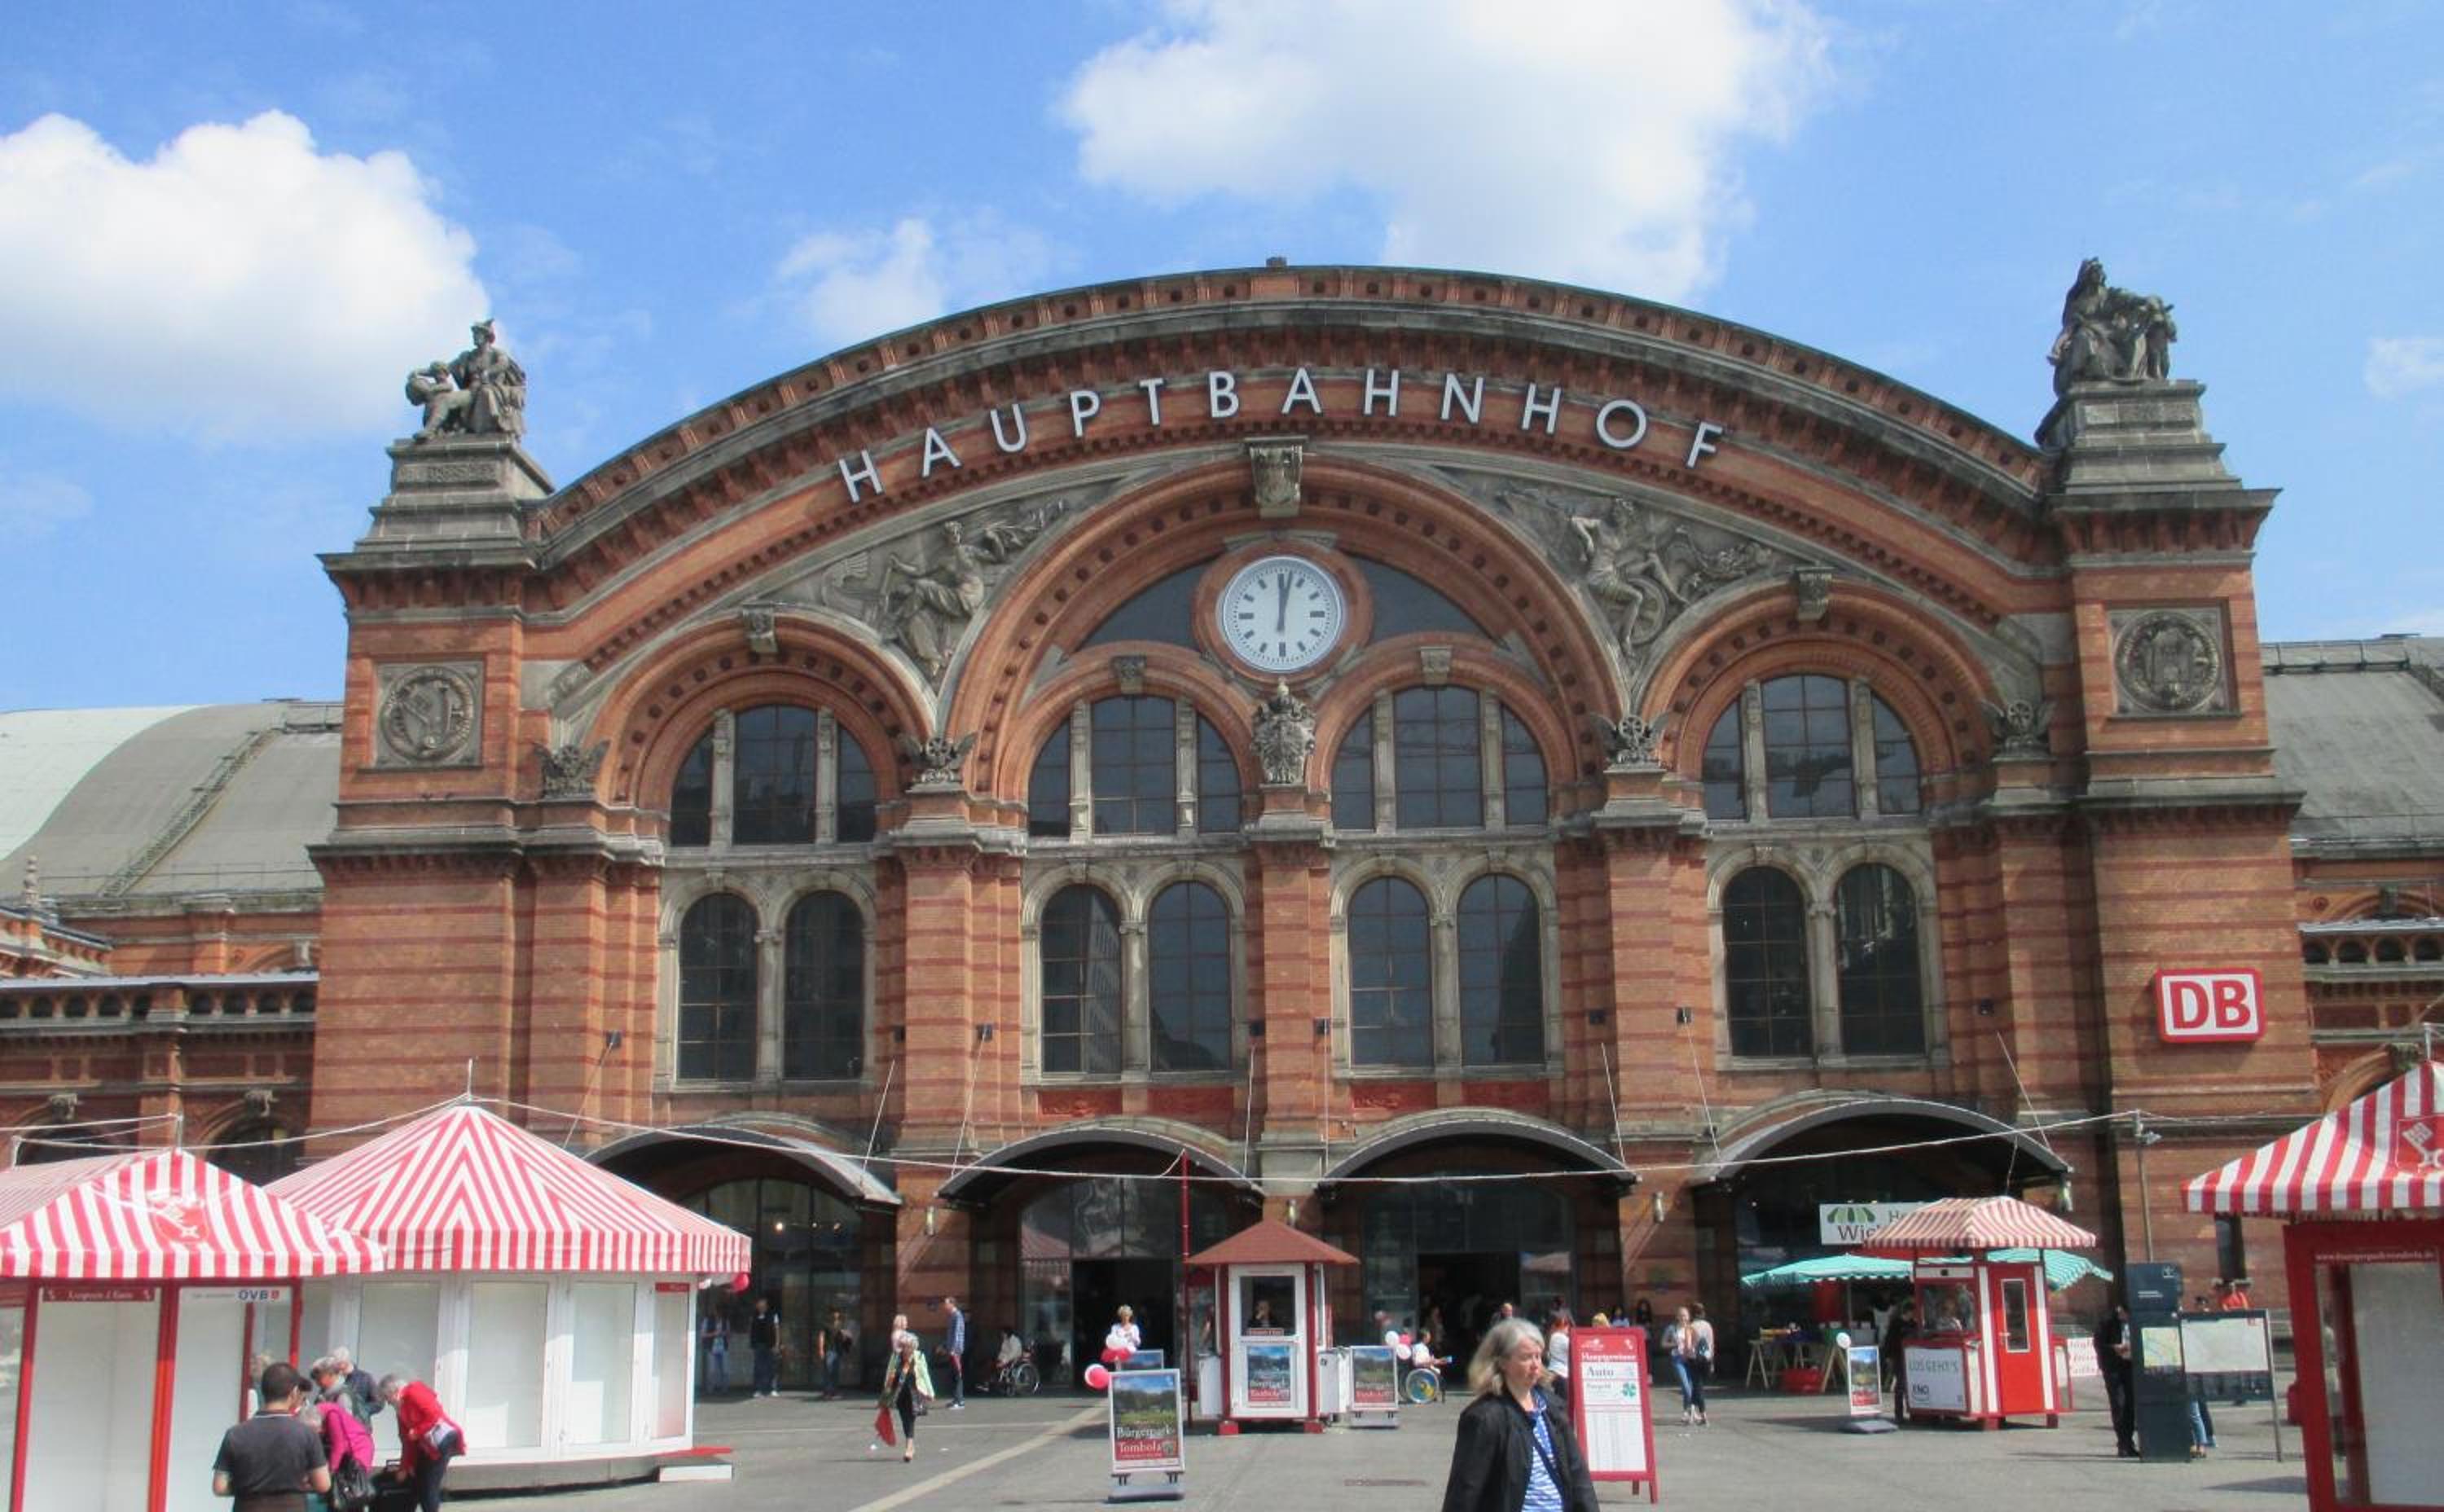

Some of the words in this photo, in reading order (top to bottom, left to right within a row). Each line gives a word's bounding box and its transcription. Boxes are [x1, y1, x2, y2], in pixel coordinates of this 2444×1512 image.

[838, 367, 1724, 503] HAUPTBAHNHOF
[2169, 979, 2251, 1030] DB
[1586, 1366, 1615, 1377] Auto
[1119, 1439, 1162, 1453] Tombola
